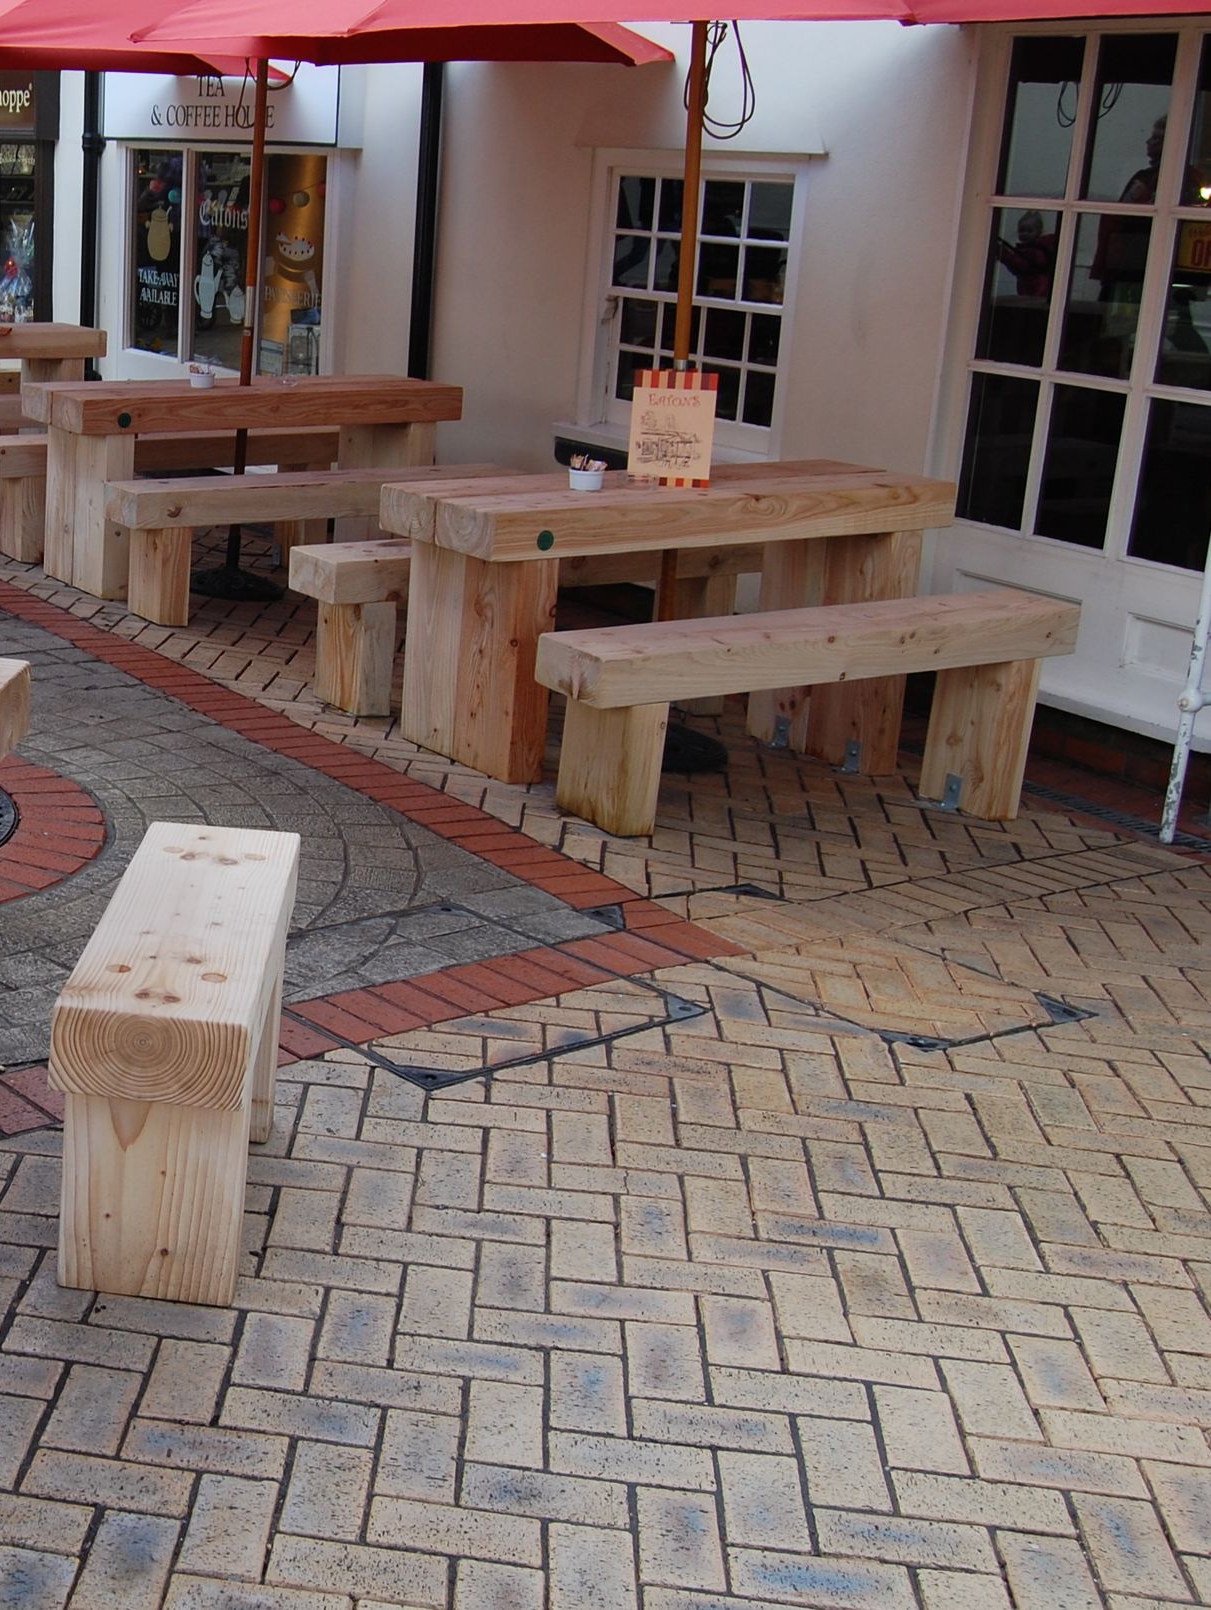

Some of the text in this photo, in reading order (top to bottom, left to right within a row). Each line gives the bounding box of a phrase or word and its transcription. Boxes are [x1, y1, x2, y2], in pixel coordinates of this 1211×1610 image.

[198, 75, 225, 97] TEA
[151, 105, 275, 129] & COFFEE HOUE
